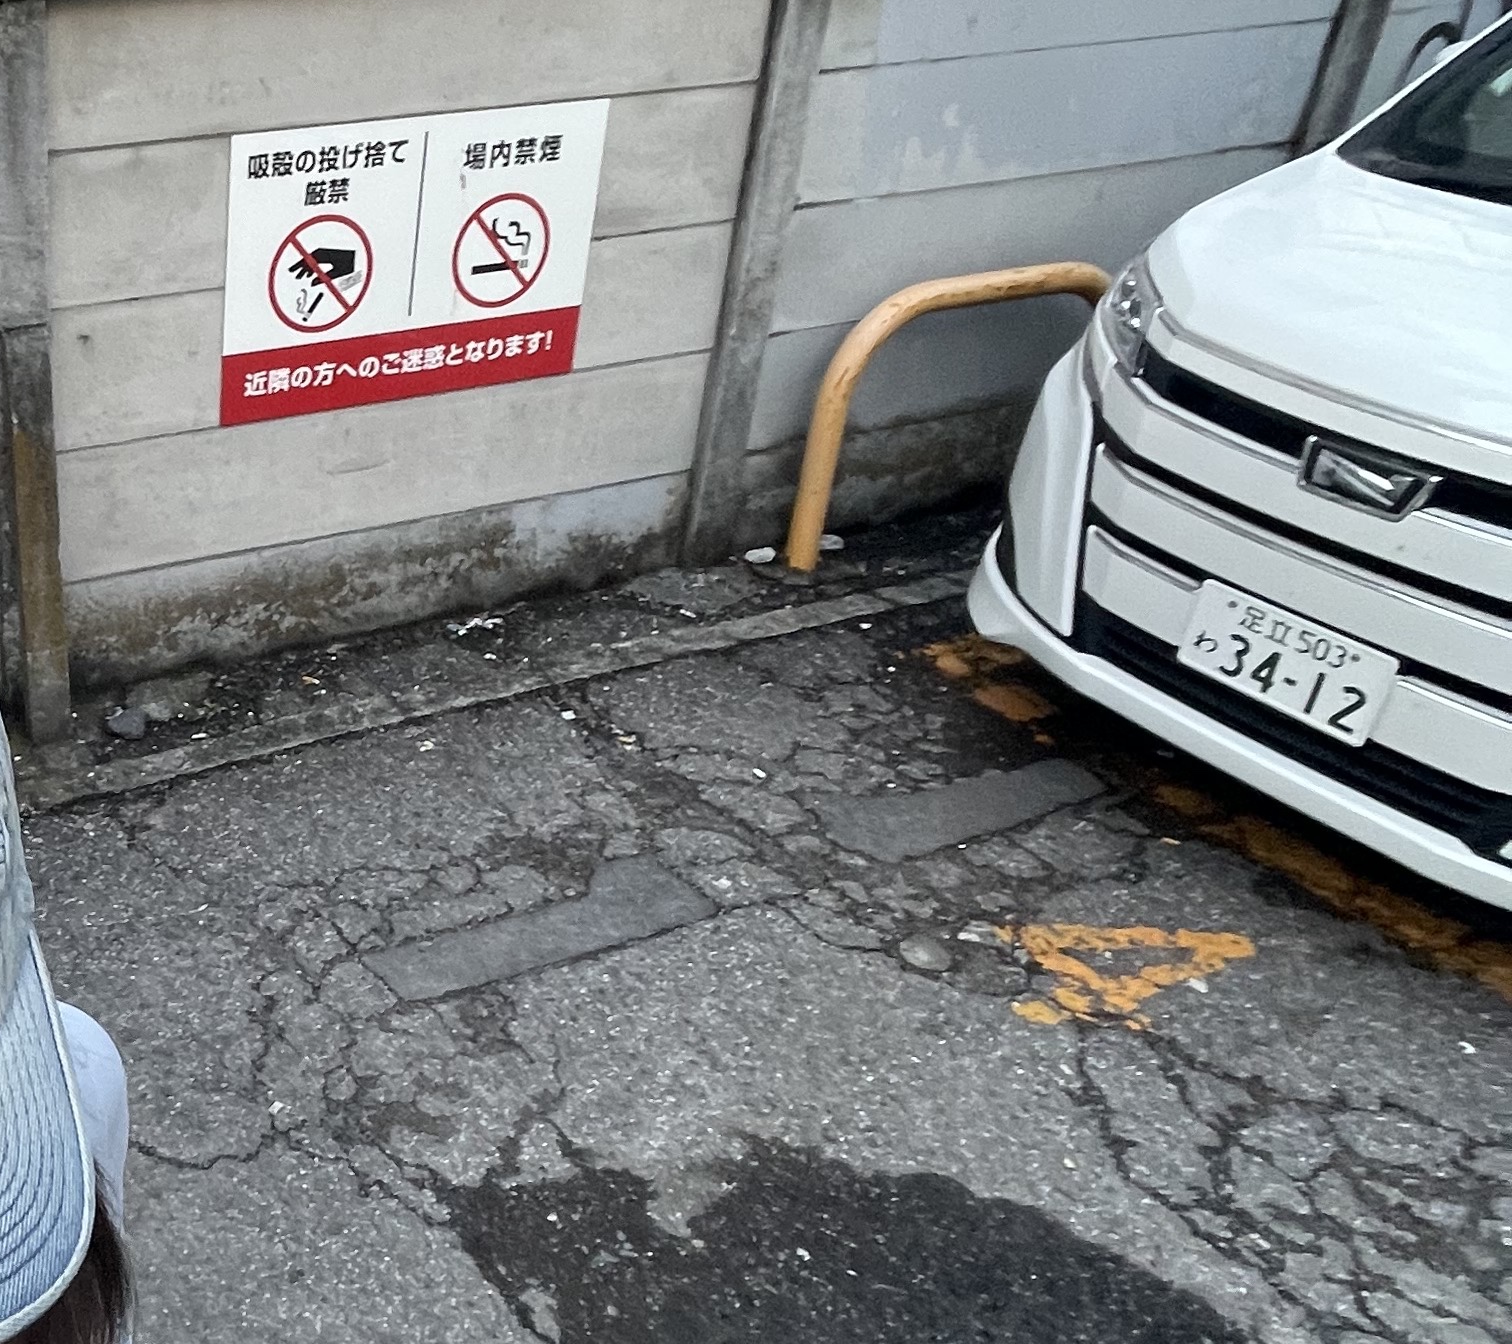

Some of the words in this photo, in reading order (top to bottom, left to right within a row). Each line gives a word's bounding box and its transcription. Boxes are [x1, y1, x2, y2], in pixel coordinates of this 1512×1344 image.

[246, 138, 410, 179] 吸殻の投げ捨て
[462, 134, 564, 171] 場内禁煙
[304, 177, 351, 206] 厳禁
[243, 329, 554, 398] 近隣の方へのご迷惑となります!
[1294, 629, 1348, 669] 503
[1218, 632, 1368, 736] 34-12
